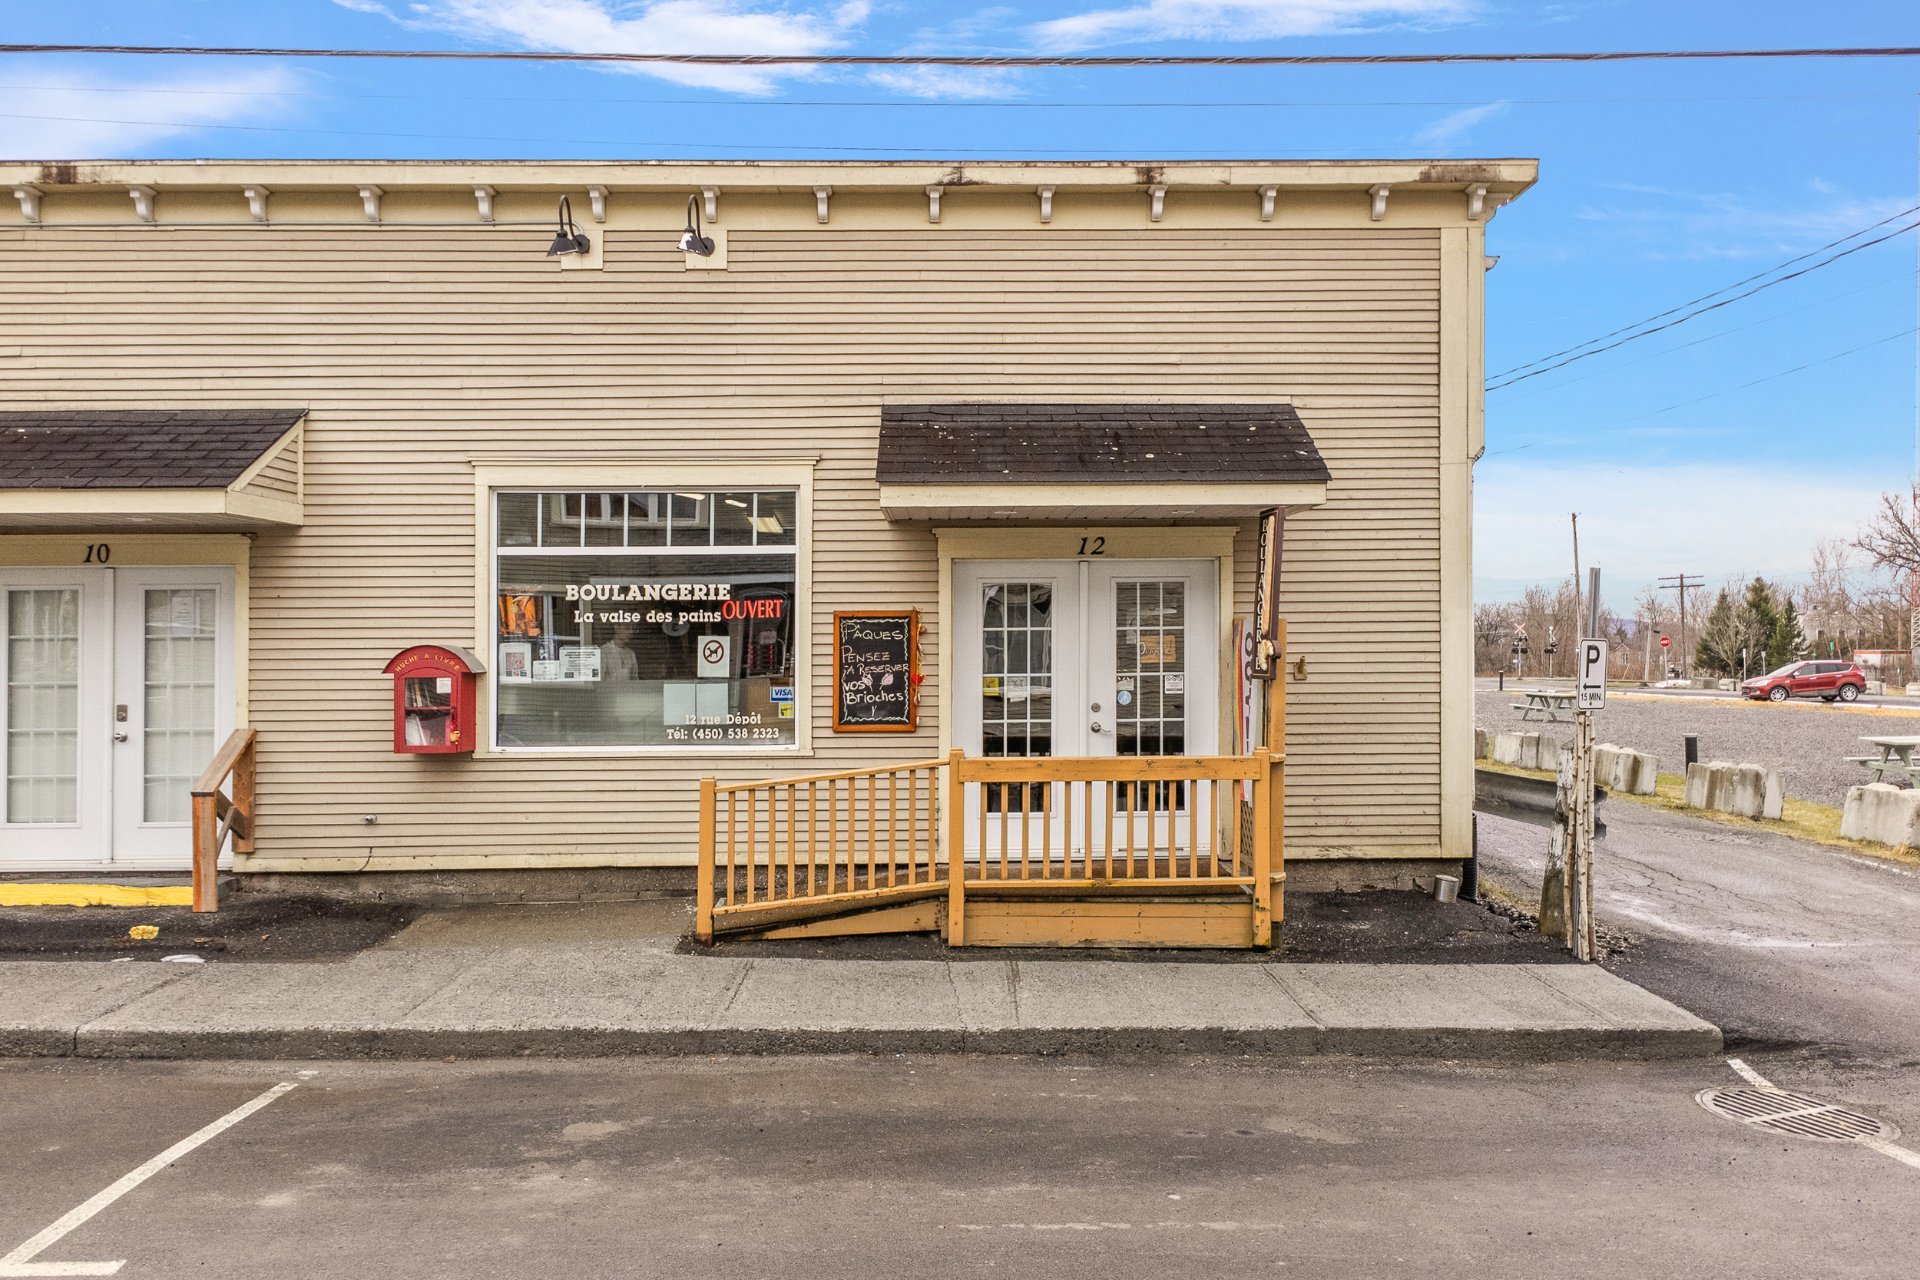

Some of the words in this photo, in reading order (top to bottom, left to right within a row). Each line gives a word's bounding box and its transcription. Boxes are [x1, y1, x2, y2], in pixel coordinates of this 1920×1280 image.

[82, 543, 111, 563] 10
[1077, 537, 1106, 555] 12
[566, 584, 731, 601] BOULANGERIE
[574, 610, 593, 623] La
[599, 610, 641, 623] valse
[646, 610, 672, 623] des
[679, 610, 722, 625] pains
[722, 599, 783, 620] OUVERT
[395, 655, 418, 672] HUCHE
[435, 654, 460, 671] LIVRE
[1586, 645, 1600, 678] P
[774, 688, 793, 697] VISA
[1581, 693, 1588, 701] 15
[685, 714, 697, 725] 12
[701, 715, 721, 725] rue
[726, 711, 762, 725] Dépôt
[666, 727, 689, 740] Tél:
[692, 728, 723, 740] (450)
[728, 728, 748, 739] 538
[753, 728, 780, 739] 2323
